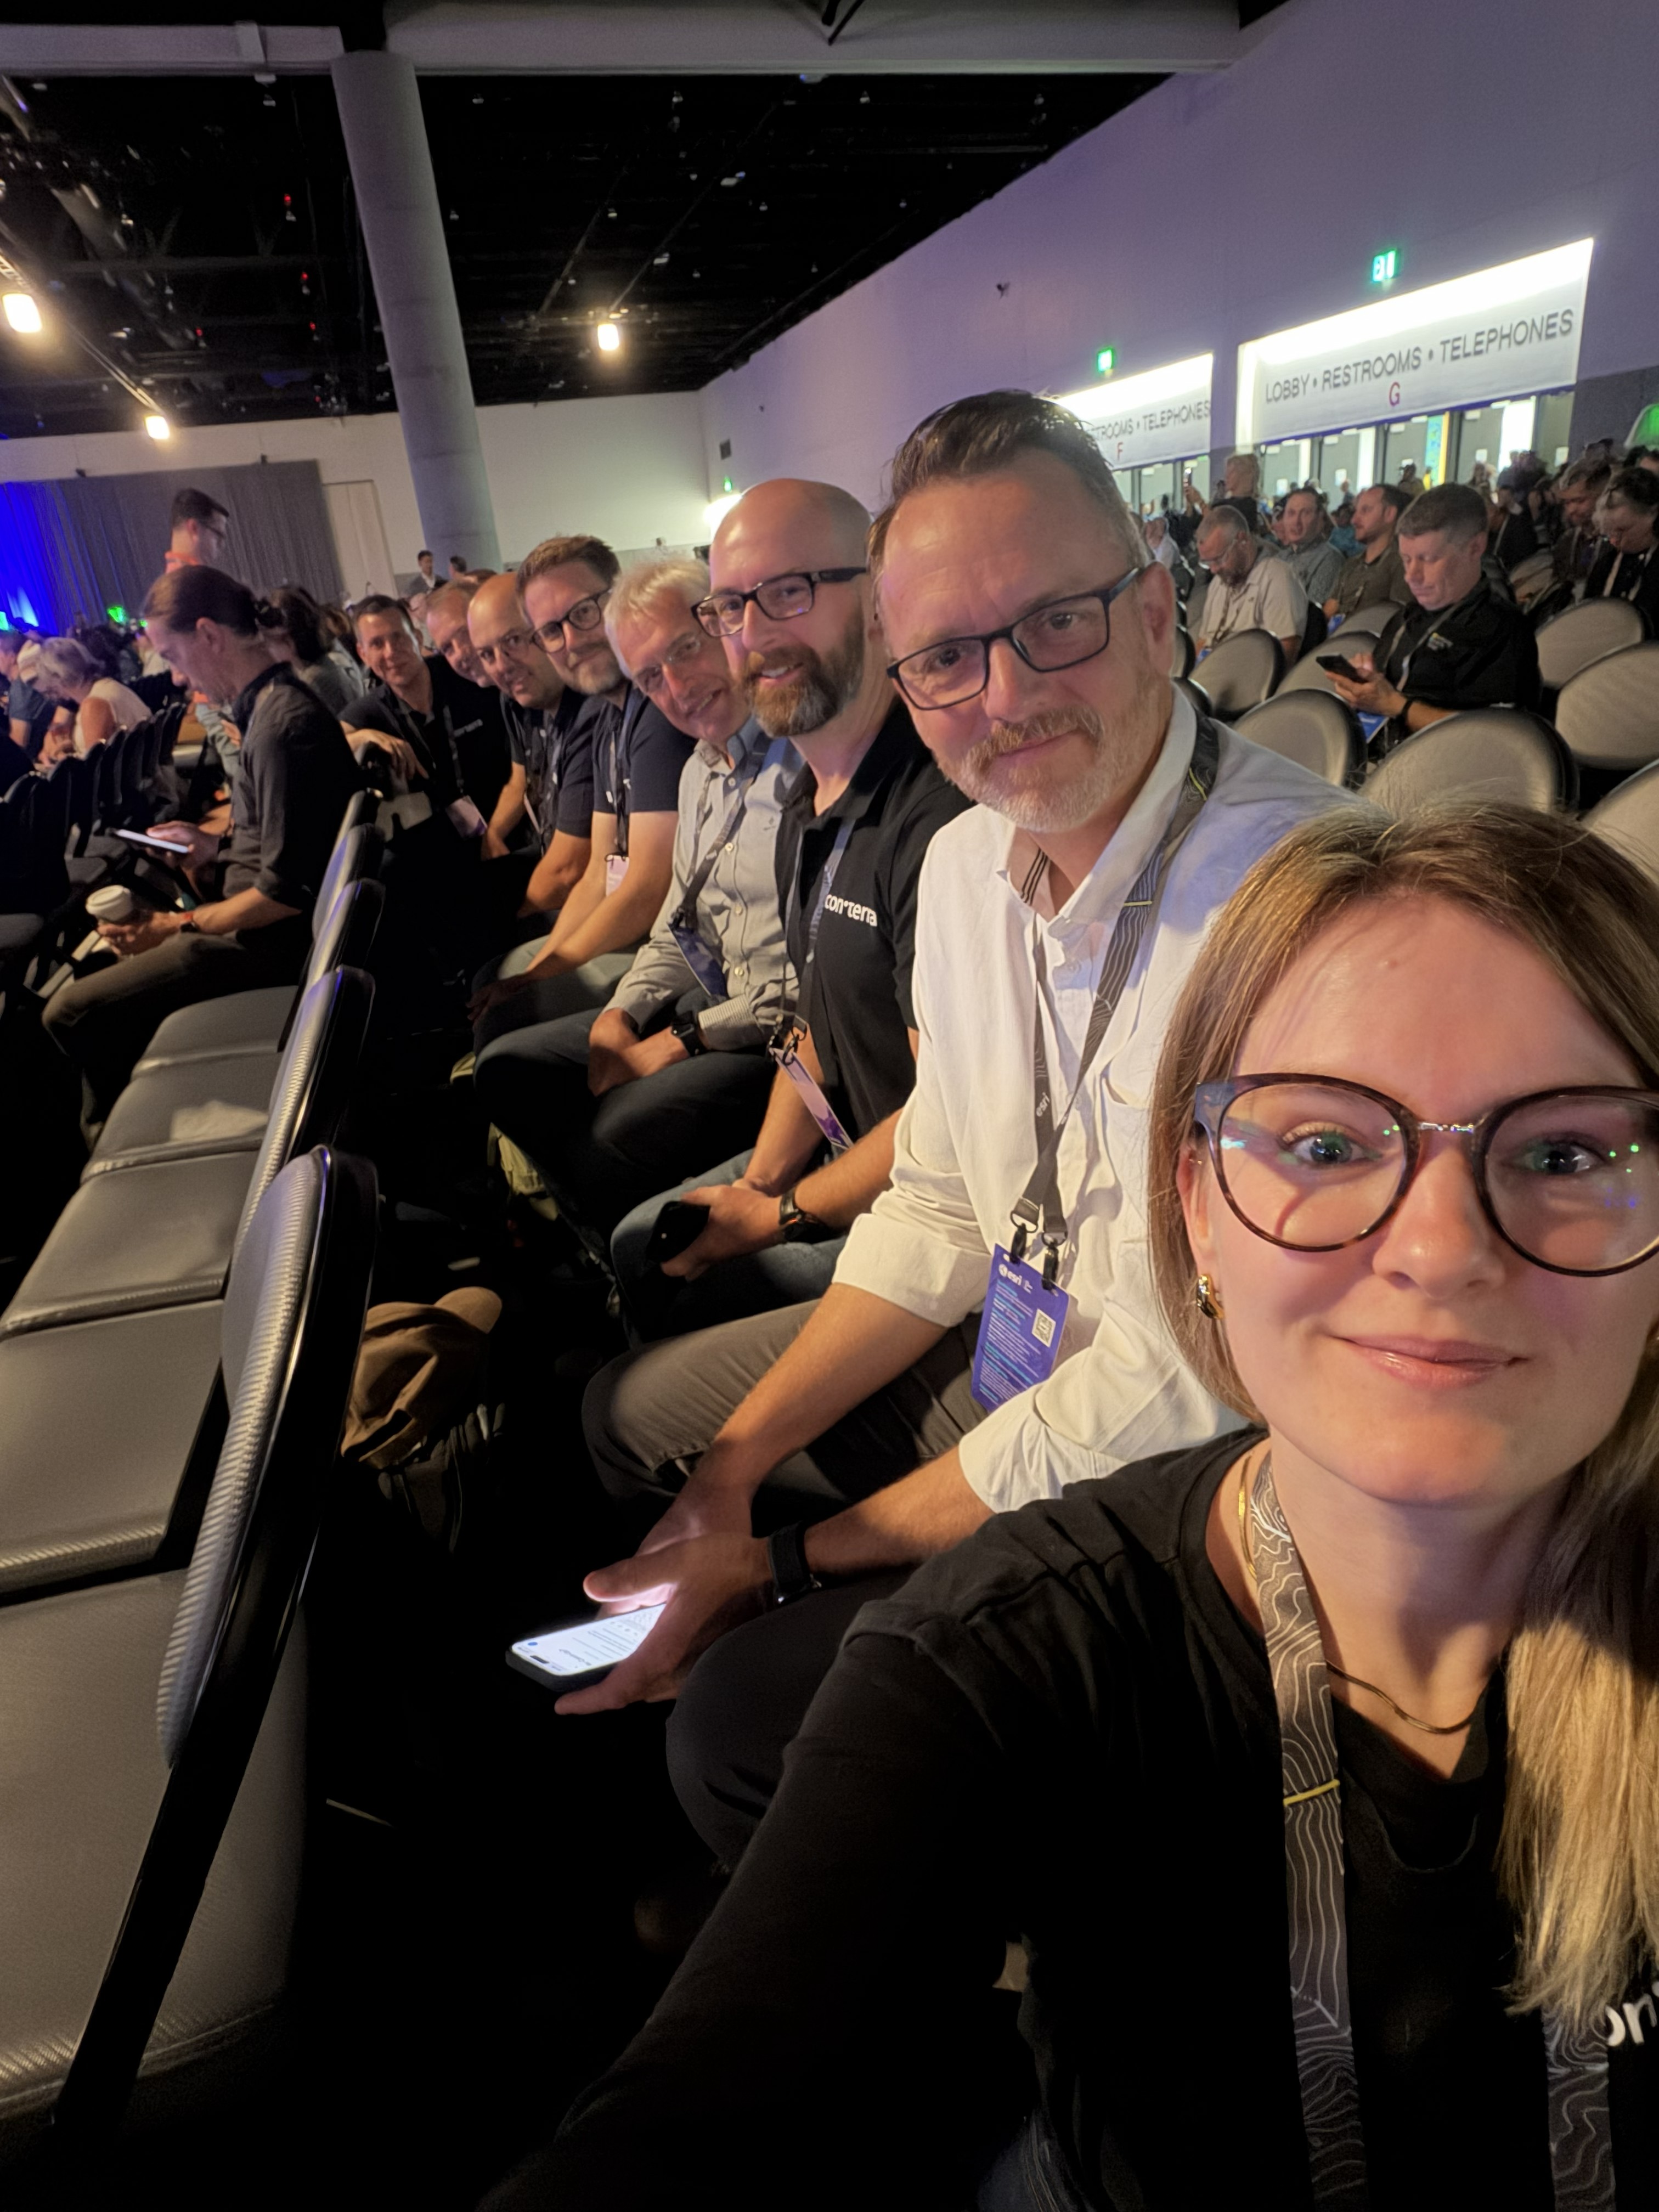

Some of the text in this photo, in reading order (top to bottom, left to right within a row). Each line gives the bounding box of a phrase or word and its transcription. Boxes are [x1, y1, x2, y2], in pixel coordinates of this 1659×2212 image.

[1266, 308, 1574, 404] LOBBY RESTROOMS TELEPHONES
[1389, 381, 1401, 407] G
[1142, 400, 1210, 432] TELEPHONES
[1116, 442, 1124, 461] F
[1036, 1092, 1050, 1117] esri
